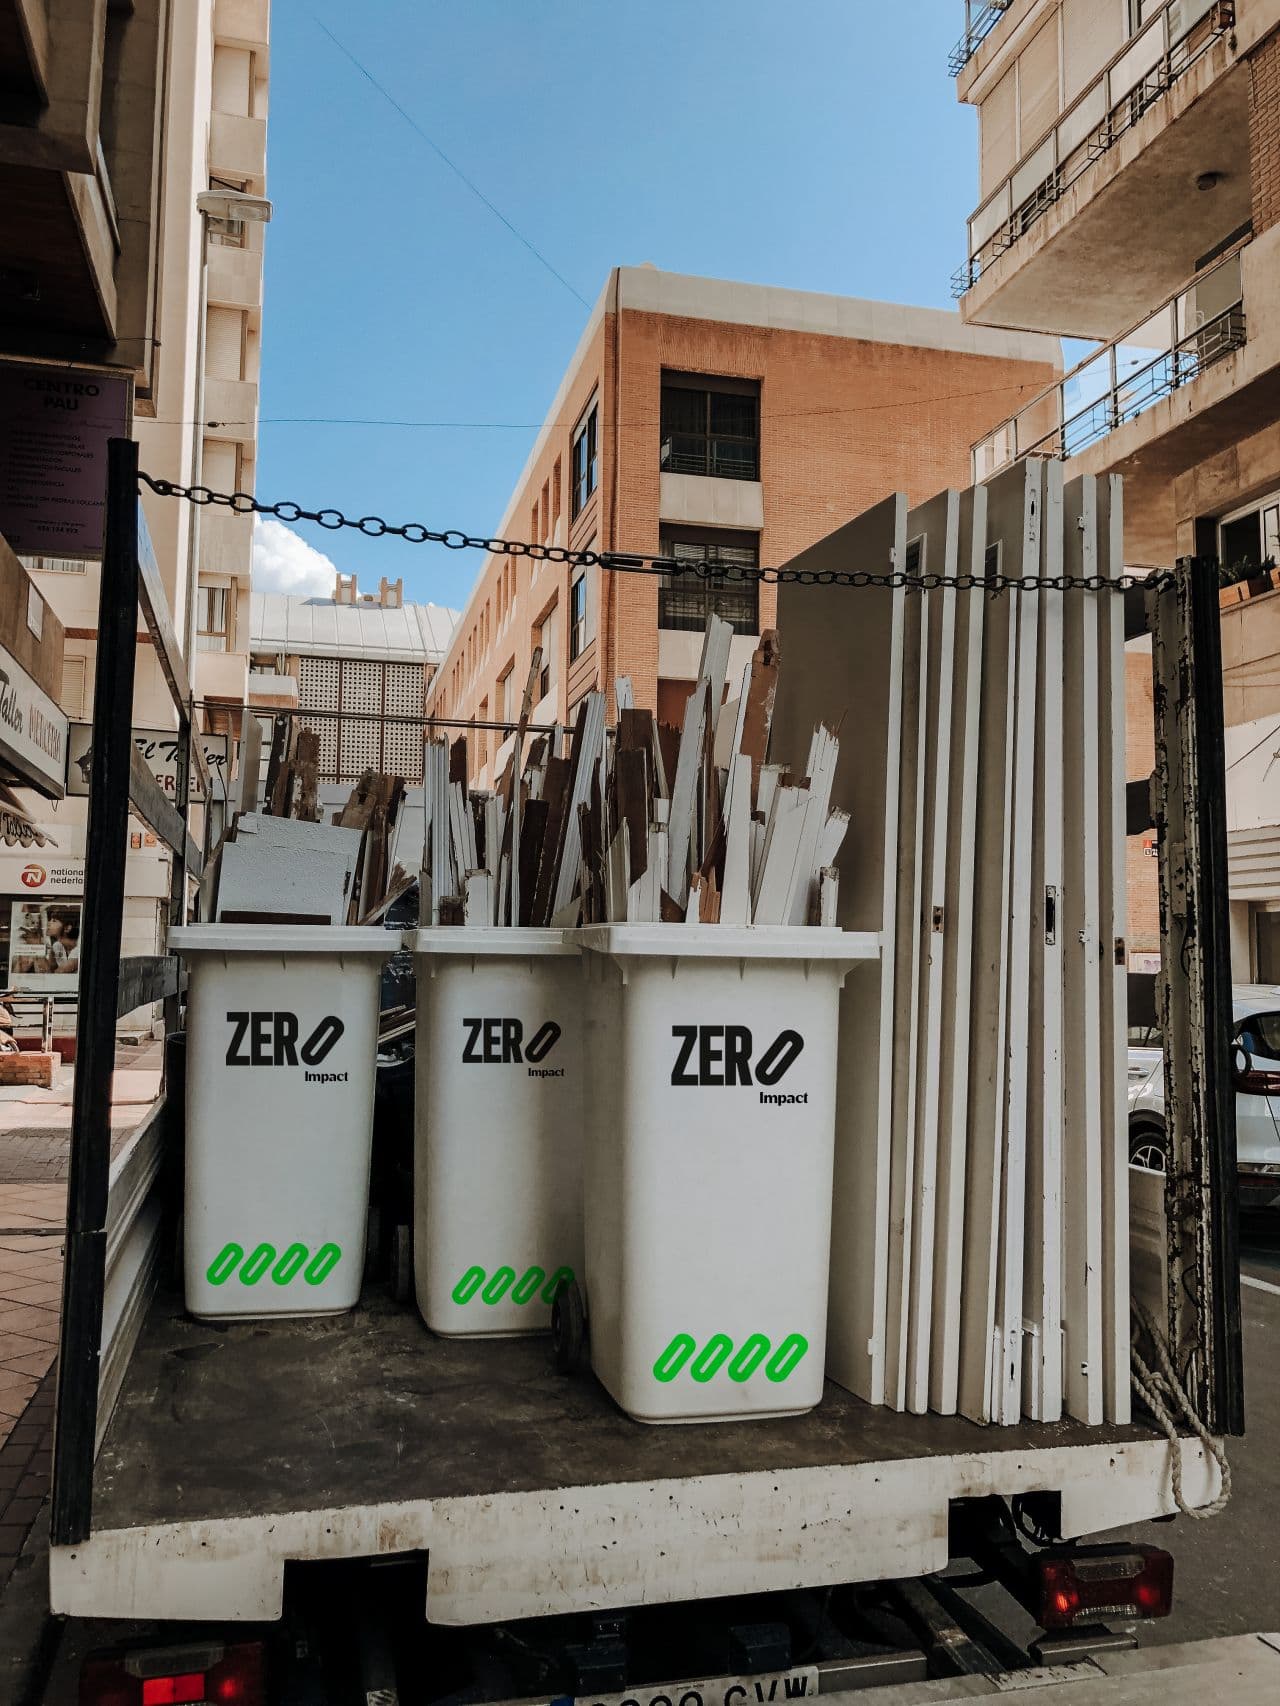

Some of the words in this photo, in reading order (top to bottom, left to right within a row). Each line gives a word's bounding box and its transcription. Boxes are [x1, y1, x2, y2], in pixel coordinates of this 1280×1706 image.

[24, 377, 100, 396] CENTRO
[43, 395, 79, 410] PAU
[158, 741, 227, 765] Ter
[51, 868, 84, 876] nationa
[50, 876, 84, 884] nederla
[304, 1070, 348, 1084] Impact
[528, 1067, 564, 1078] Impact
[759, 1091, 808, 1106] Impact
